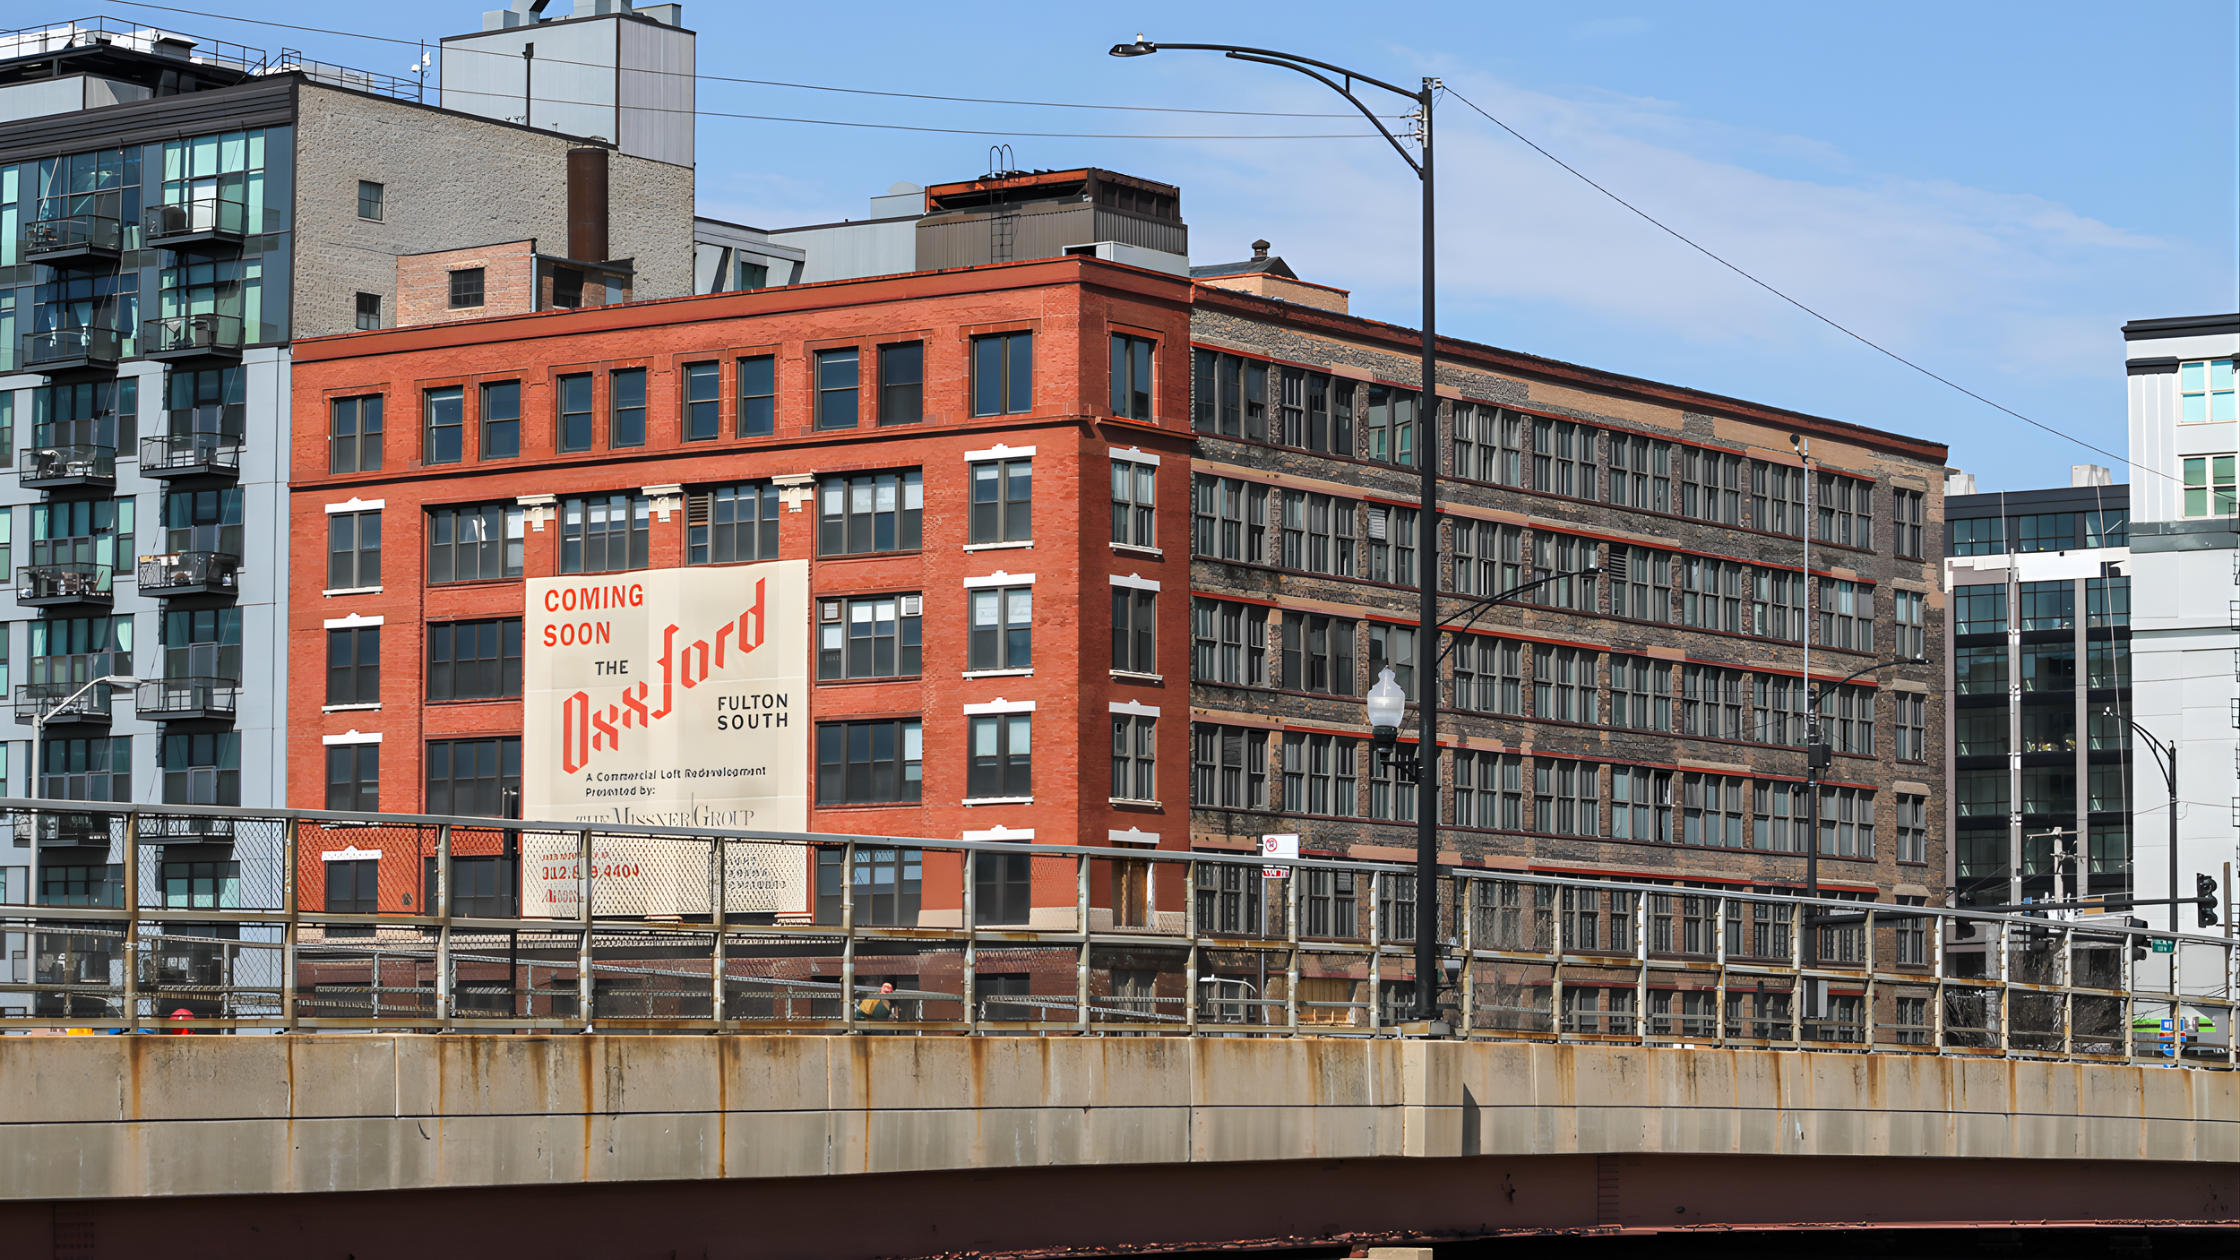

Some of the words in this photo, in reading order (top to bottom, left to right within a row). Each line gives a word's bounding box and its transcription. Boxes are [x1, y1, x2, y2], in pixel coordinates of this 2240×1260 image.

[544, 584, 643, 612] COMING
[543, 621, 611, 647] SOON
[563, 576, 766, 774] Oxxford
[595, 660, 629, 675] THE
[718, 693, 788, 711] FULTON
[717, 712, 788, 730] SOUTH
[585, 773, 593, 782] A
[596, 769, 656, 782] Commercial
[661, 769, 681, 779] Loft
[684, 766, 767, 779] Redevelopment
[585, 786, 636, 797] Presented
[639, 785, 656, 796] by:
